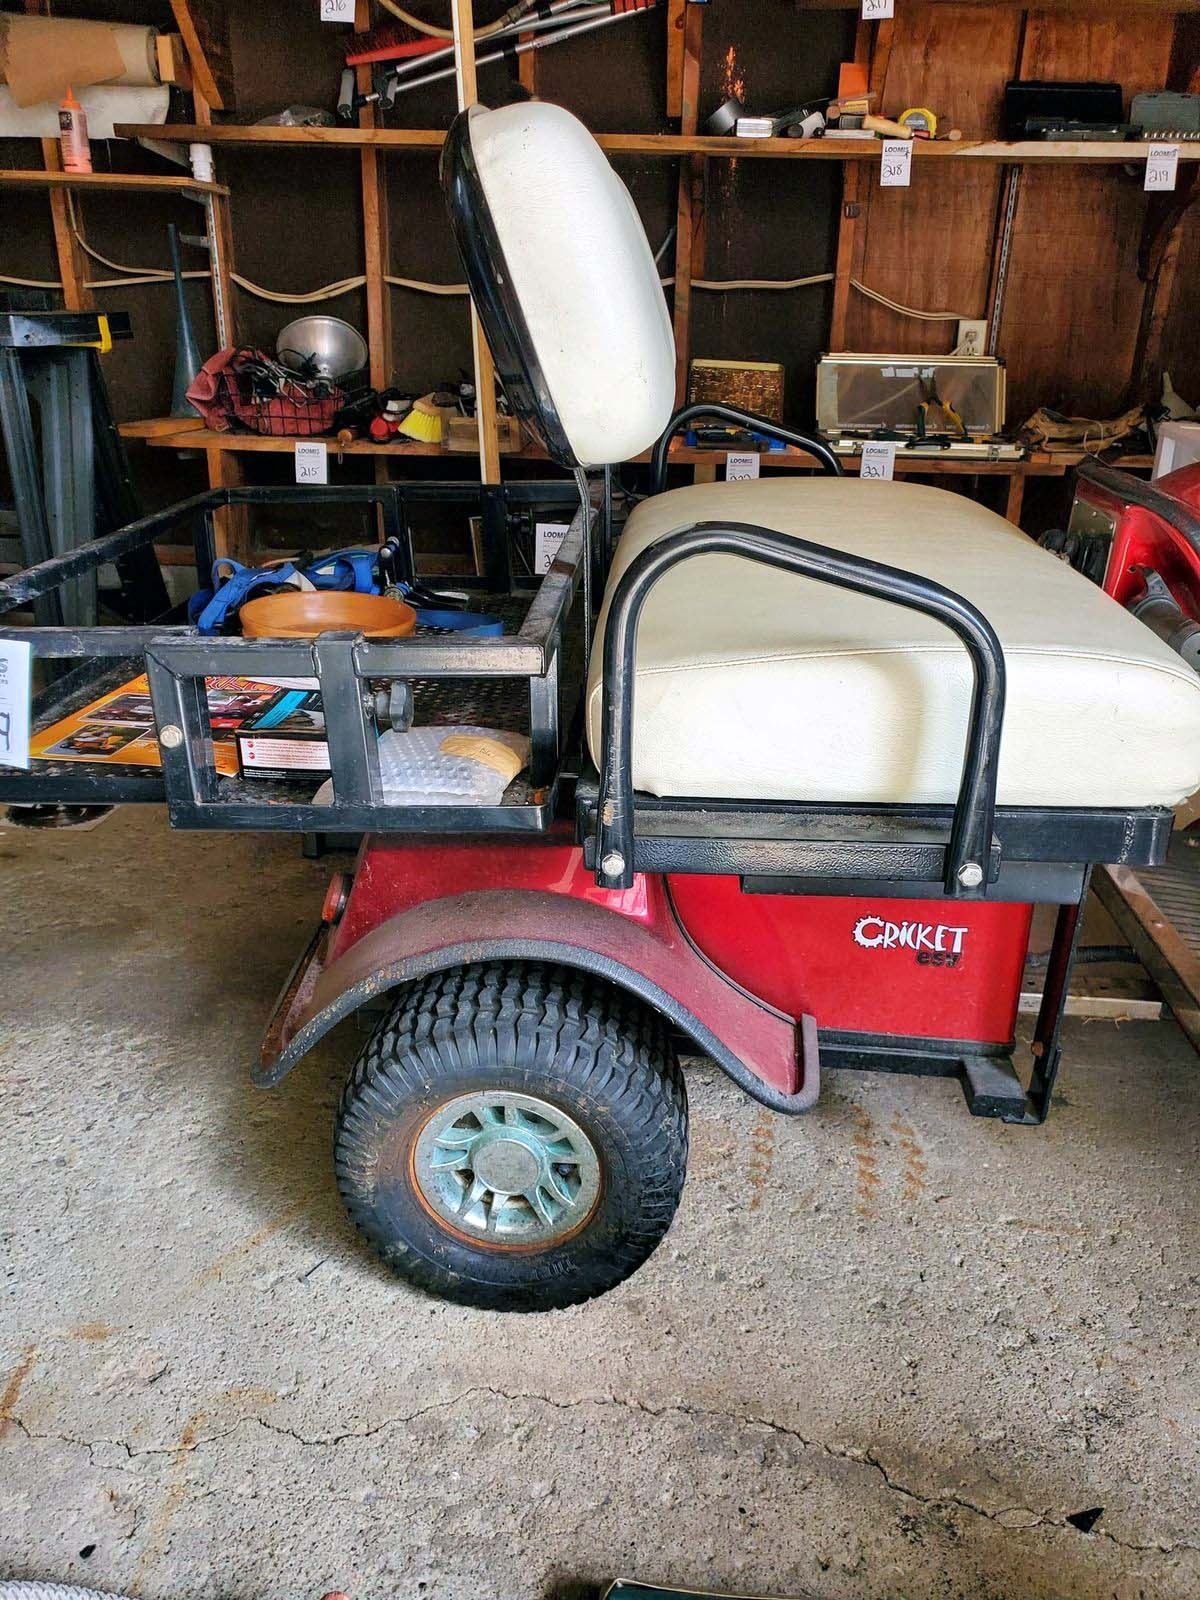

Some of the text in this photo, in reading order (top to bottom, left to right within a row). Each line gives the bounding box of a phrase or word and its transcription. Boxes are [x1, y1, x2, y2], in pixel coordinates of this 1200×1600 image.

[882, 164, 903, 178] 218
[1148, 169, 1169, 183] 219
[300, 466, 320, 477] 215
[862, 465, 886, 478] 221
